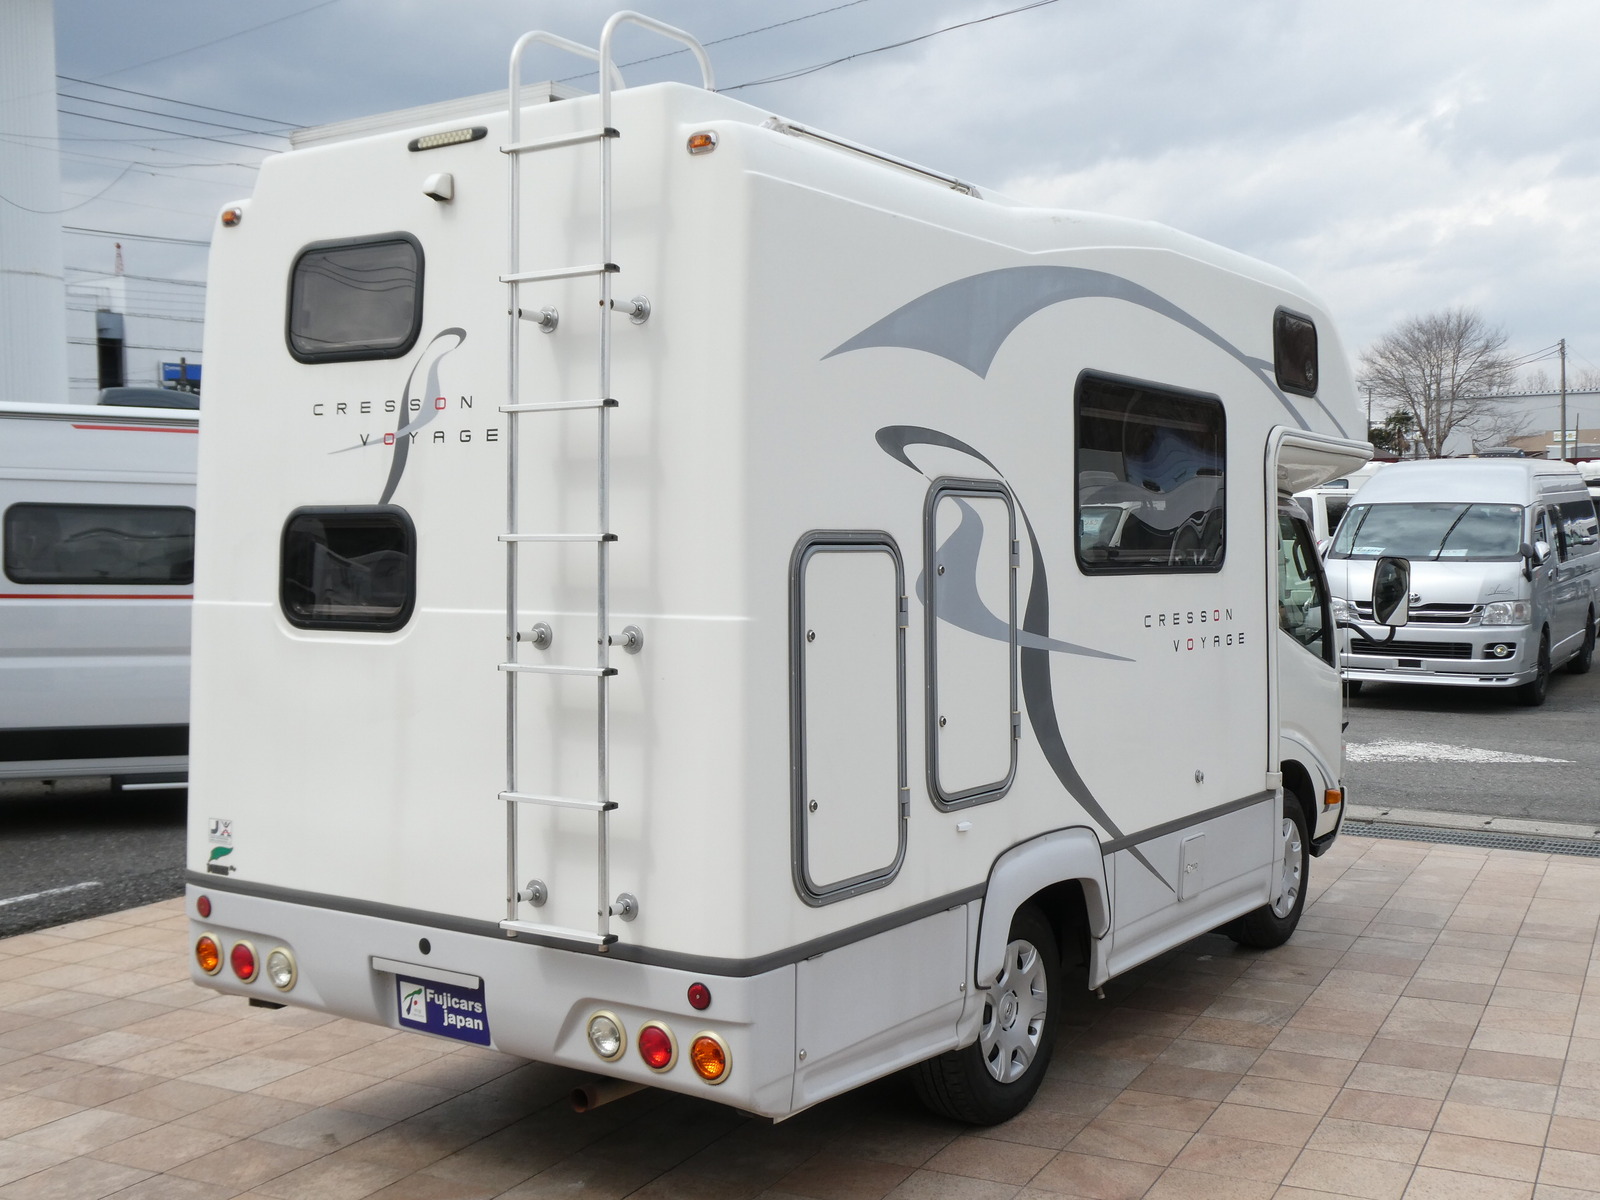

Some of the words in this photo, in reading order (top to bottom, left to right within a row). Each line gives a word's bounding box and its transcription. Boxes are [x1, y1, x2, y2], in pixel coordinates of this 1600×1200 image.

[313, 395, 472, 416] CRESSON
[359, 428, 499, 446] VOYAGE
[1143, 608, 1233, 628] CRESSON
[1173, 632, 1245, 652] VOYAGE
[426, 988, 483, 1013] Fujicars
[443, 1009, 483, 1031] japan
